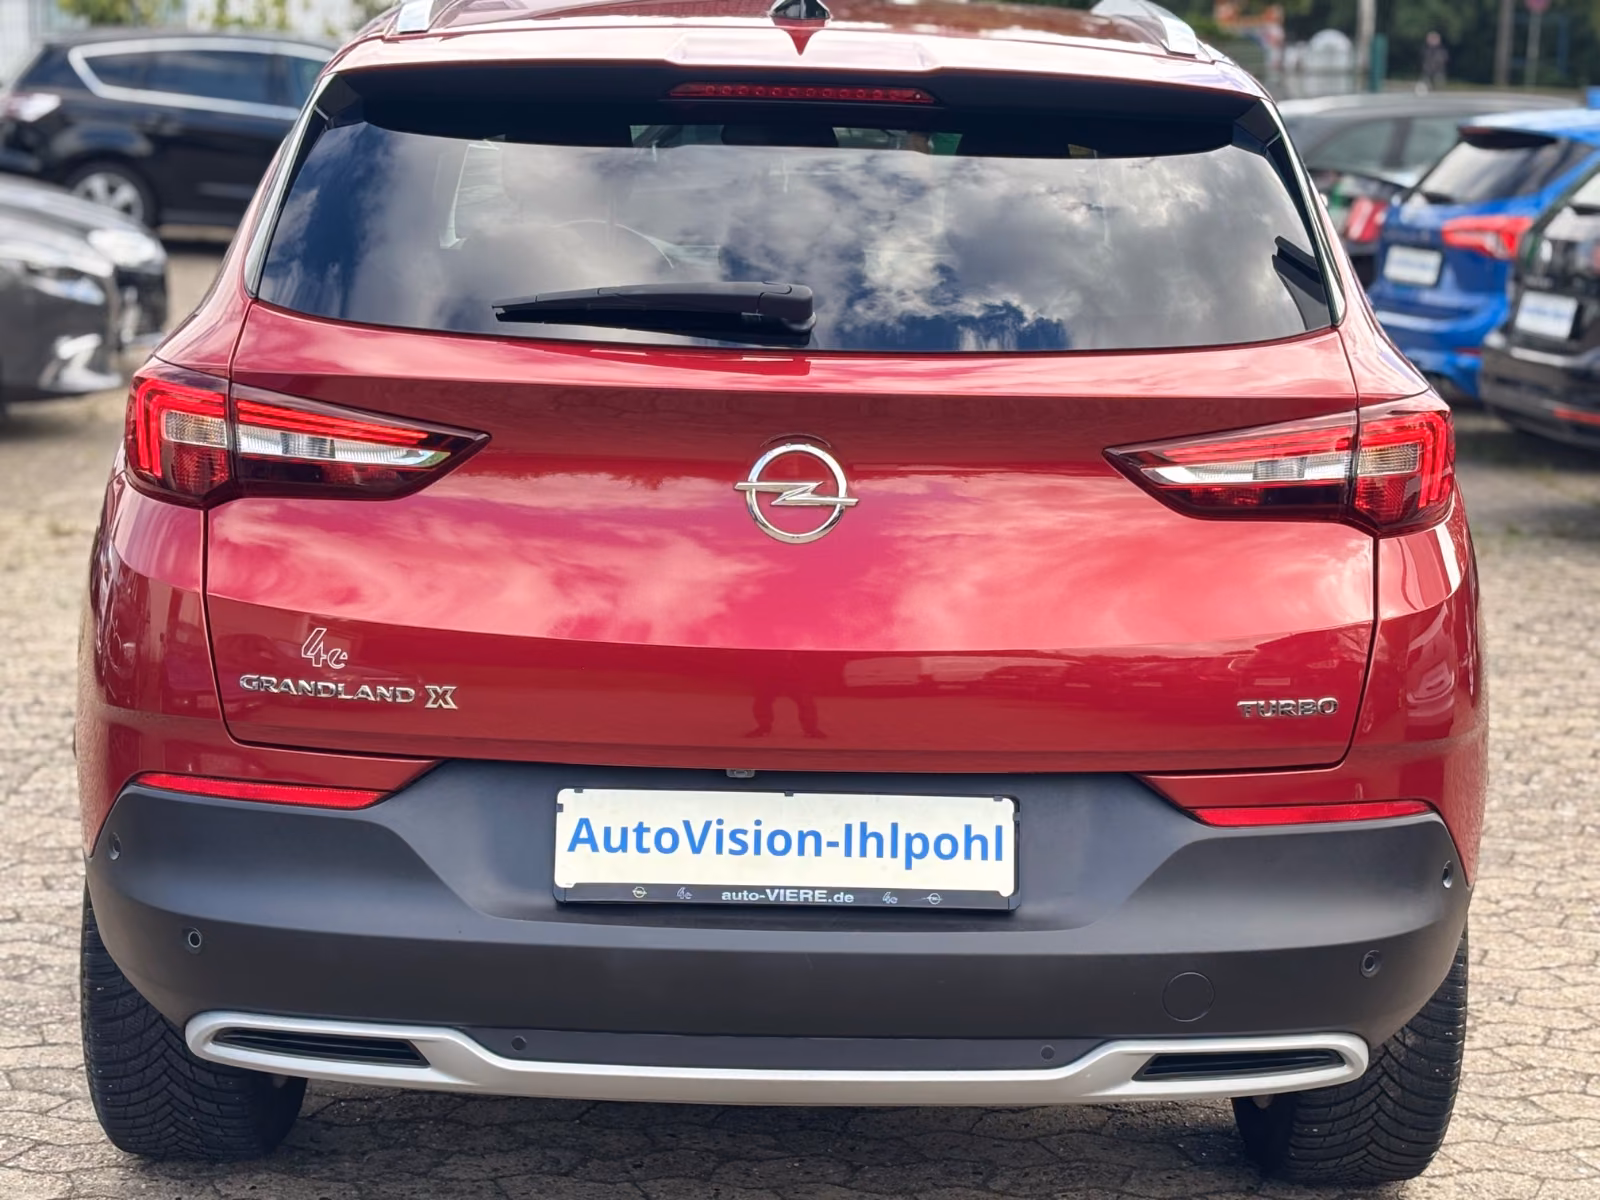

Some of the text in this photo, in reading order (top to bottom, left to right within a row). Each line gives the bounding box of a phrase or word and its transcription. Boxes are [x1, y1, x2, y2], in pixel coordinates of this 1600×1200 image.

[239, 674, 458, 709] GRANDLAND X
[1236, 697, 1338, 718] TURBO
[567, 817, 1004, 870] AutoVision-Ihlpohl
[721, 888, 855, 904] auto-VIERE.de
